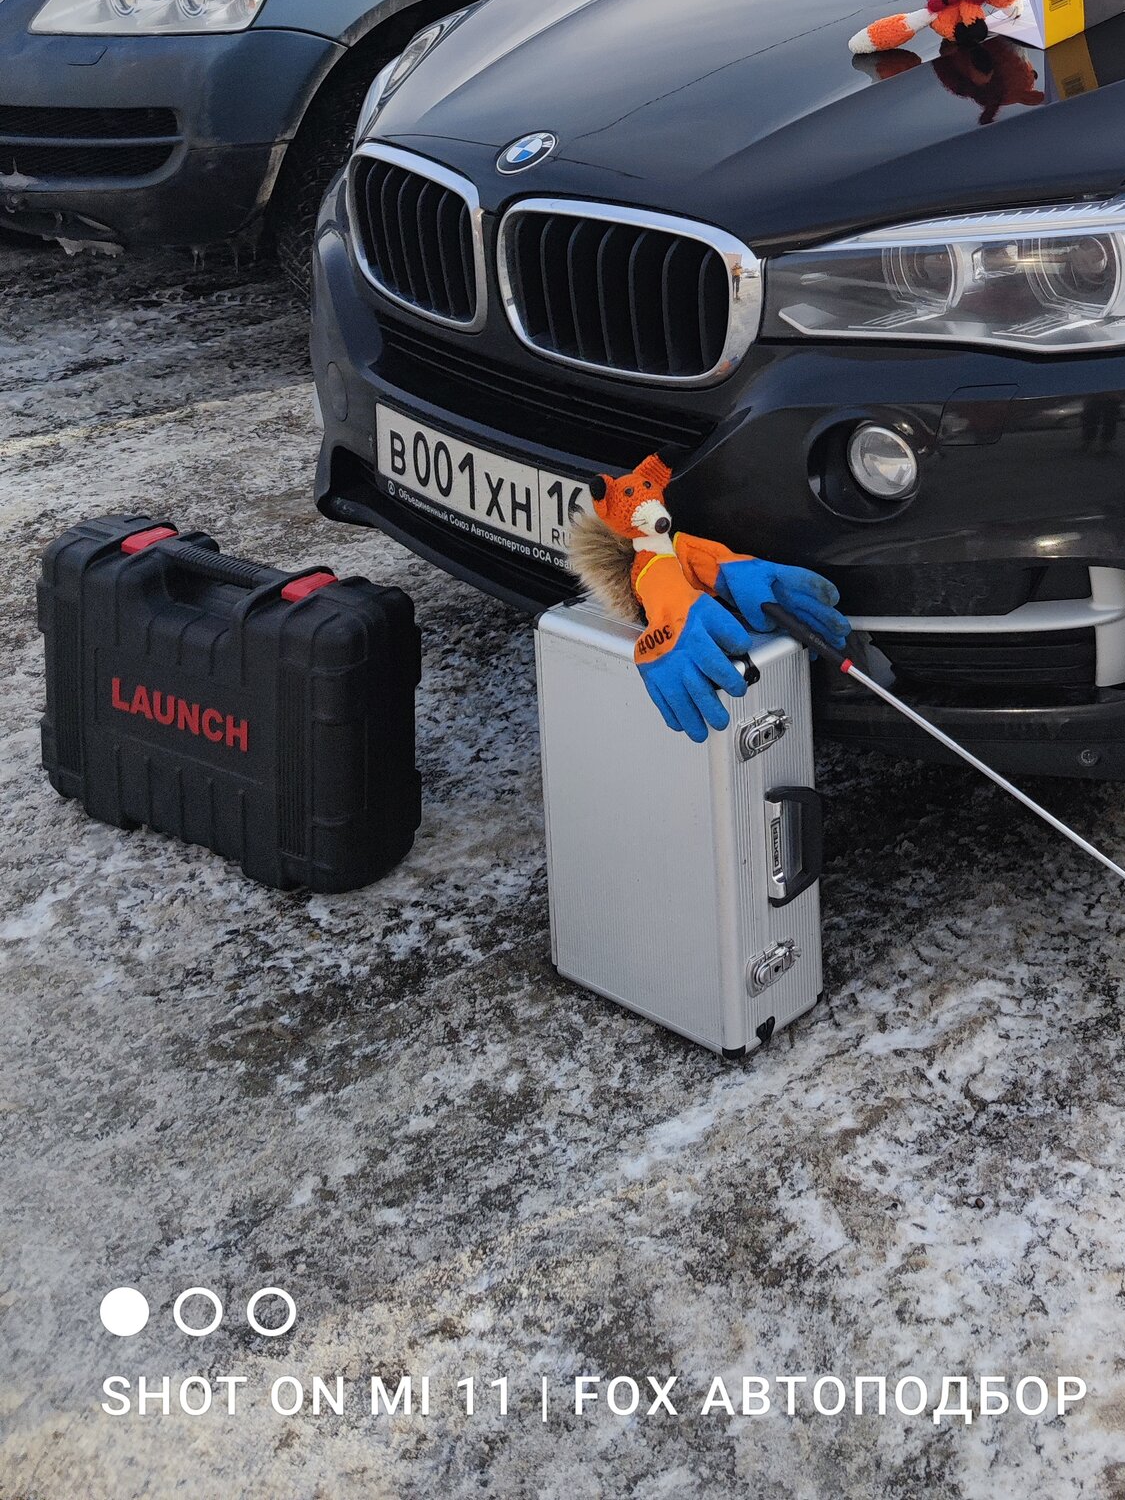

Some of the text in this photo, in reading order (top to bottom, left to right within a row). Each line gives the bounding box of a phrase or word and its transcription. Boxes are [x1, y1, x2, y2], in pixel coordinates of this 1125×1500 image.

[390, 429, 532, 532] В001ХН
[449, 513, 469, 531] Союз
[470, 522, 531, 556] Автоэкспертов
[532, 547, 552, 564] ОСА
[551, 527, 572, 549] RU
[111, 677, 248, 753] LAUNCH
